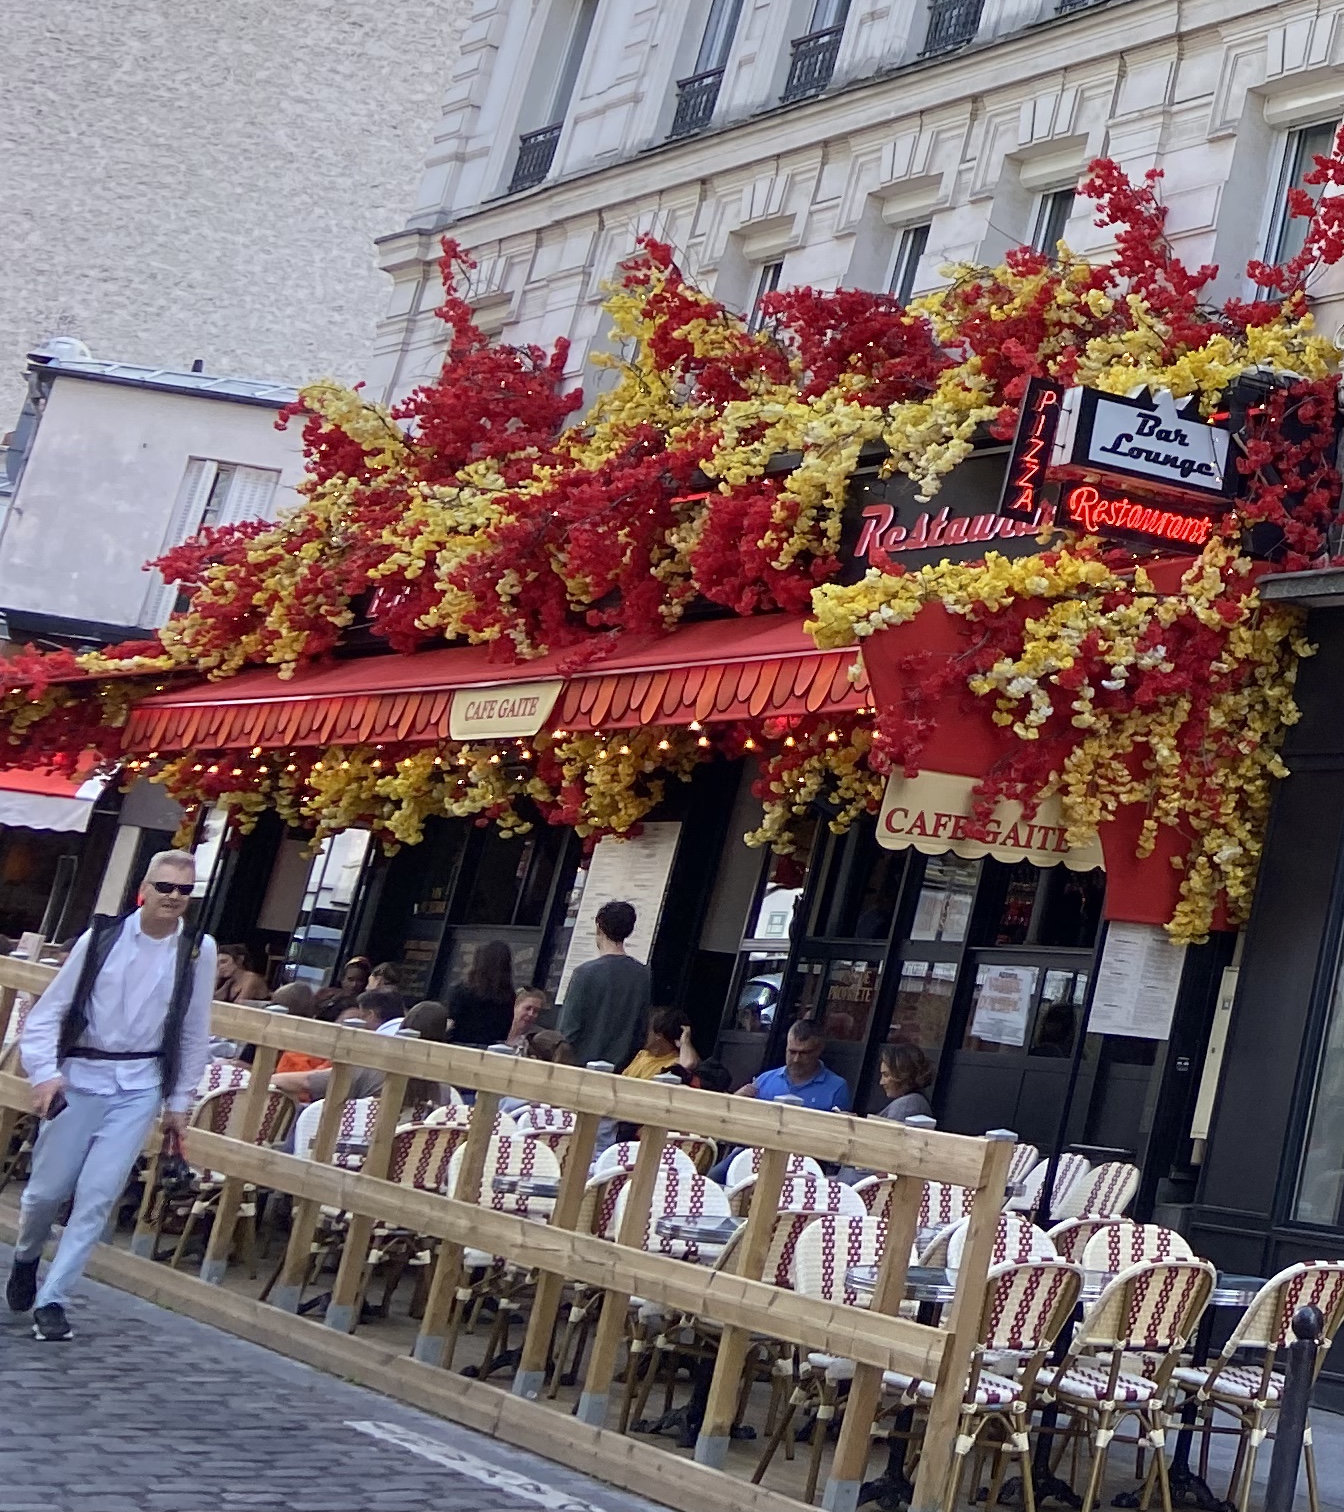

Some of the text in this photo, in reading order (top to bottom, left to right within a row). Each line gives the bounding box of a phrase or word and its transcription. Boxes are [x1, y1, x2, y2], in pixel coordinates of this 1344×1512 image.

[1012, 390, 1057, 513] PIZZA
[1135, 412, 1190, 447] Bar
[1099, 433, 1215, 478] Lounge
[1069, 486, 1213, 545] Restaurant
[465, 697, 540, 721] CAFE GAITE
